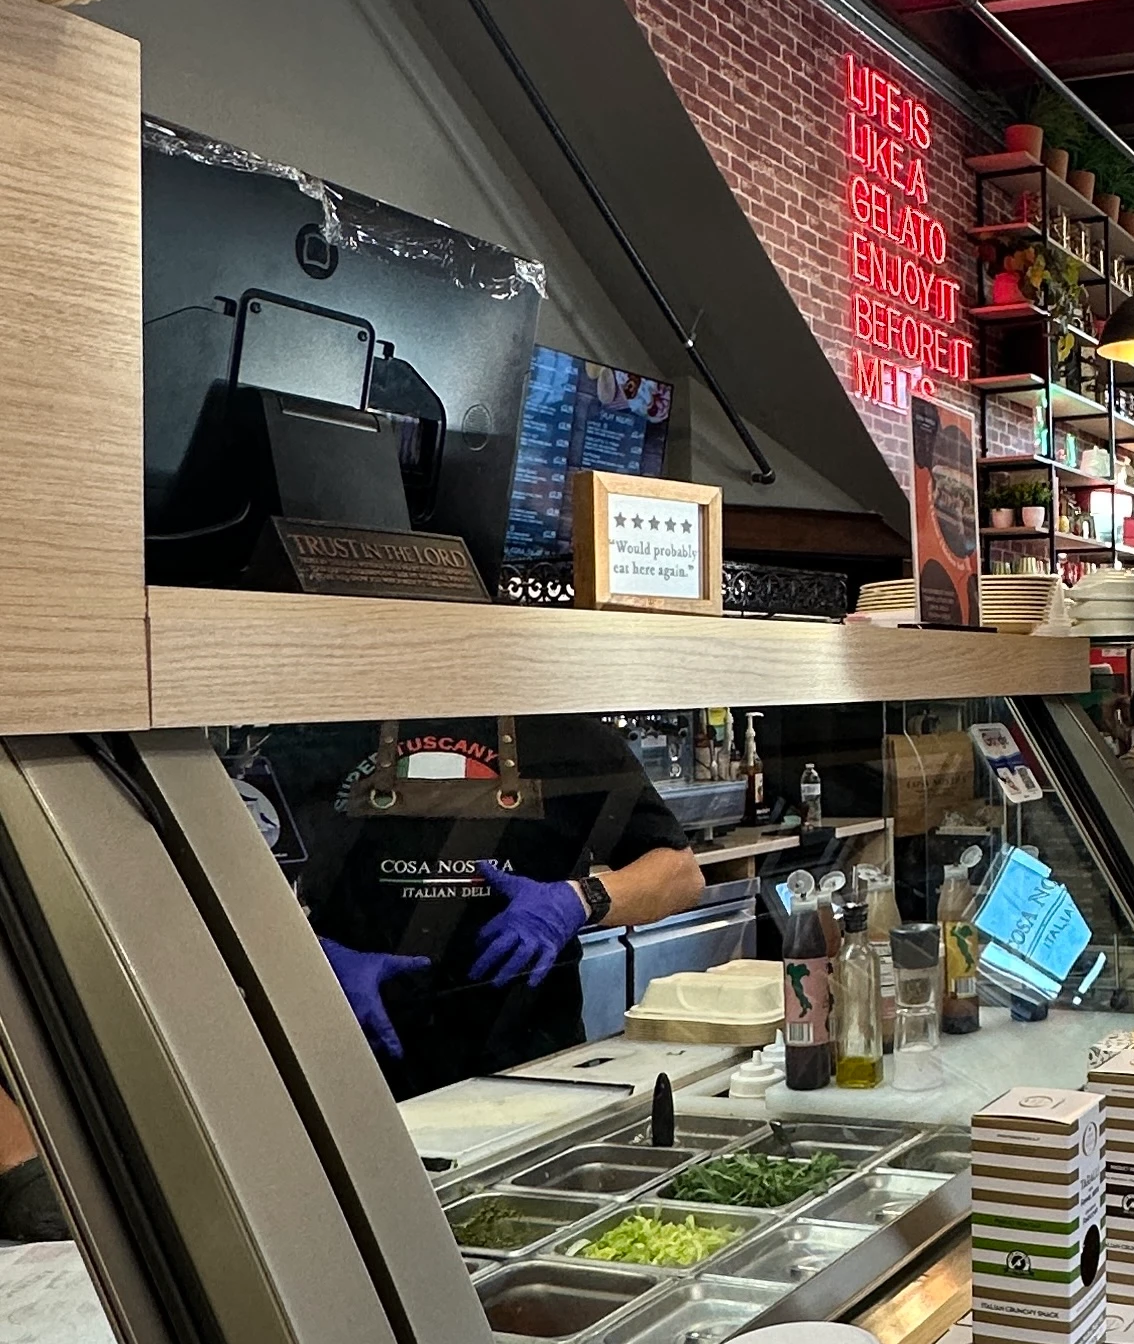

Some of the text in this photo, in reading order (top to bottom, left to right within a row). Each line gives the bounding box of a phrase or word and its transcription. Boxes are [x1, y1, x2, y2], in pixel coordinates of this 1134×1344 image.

[847, 54, 931, 149] LIFE IS
[848, 112, 929, 205] LIKE A
[850, 174, 946, 265] GELATO
[852, 231, 961, 324] ENJOY IT
[853, 293, 973, 381] BEFORE IT
[287, 533, 359, 559] TRUST
[360, 542, 381, 560] IN
[412, 545, 468, 569] LORD
[613, 564, 629, 574] eat
[632, 561, 655, 575] here
[654, 544, 699, 562] probably
[397, 735, 499, 763] TUSCANY
[380, 859, 514, 874] COSA NOSRA
[402, 886, 491, 898] ITALIAN DELI
